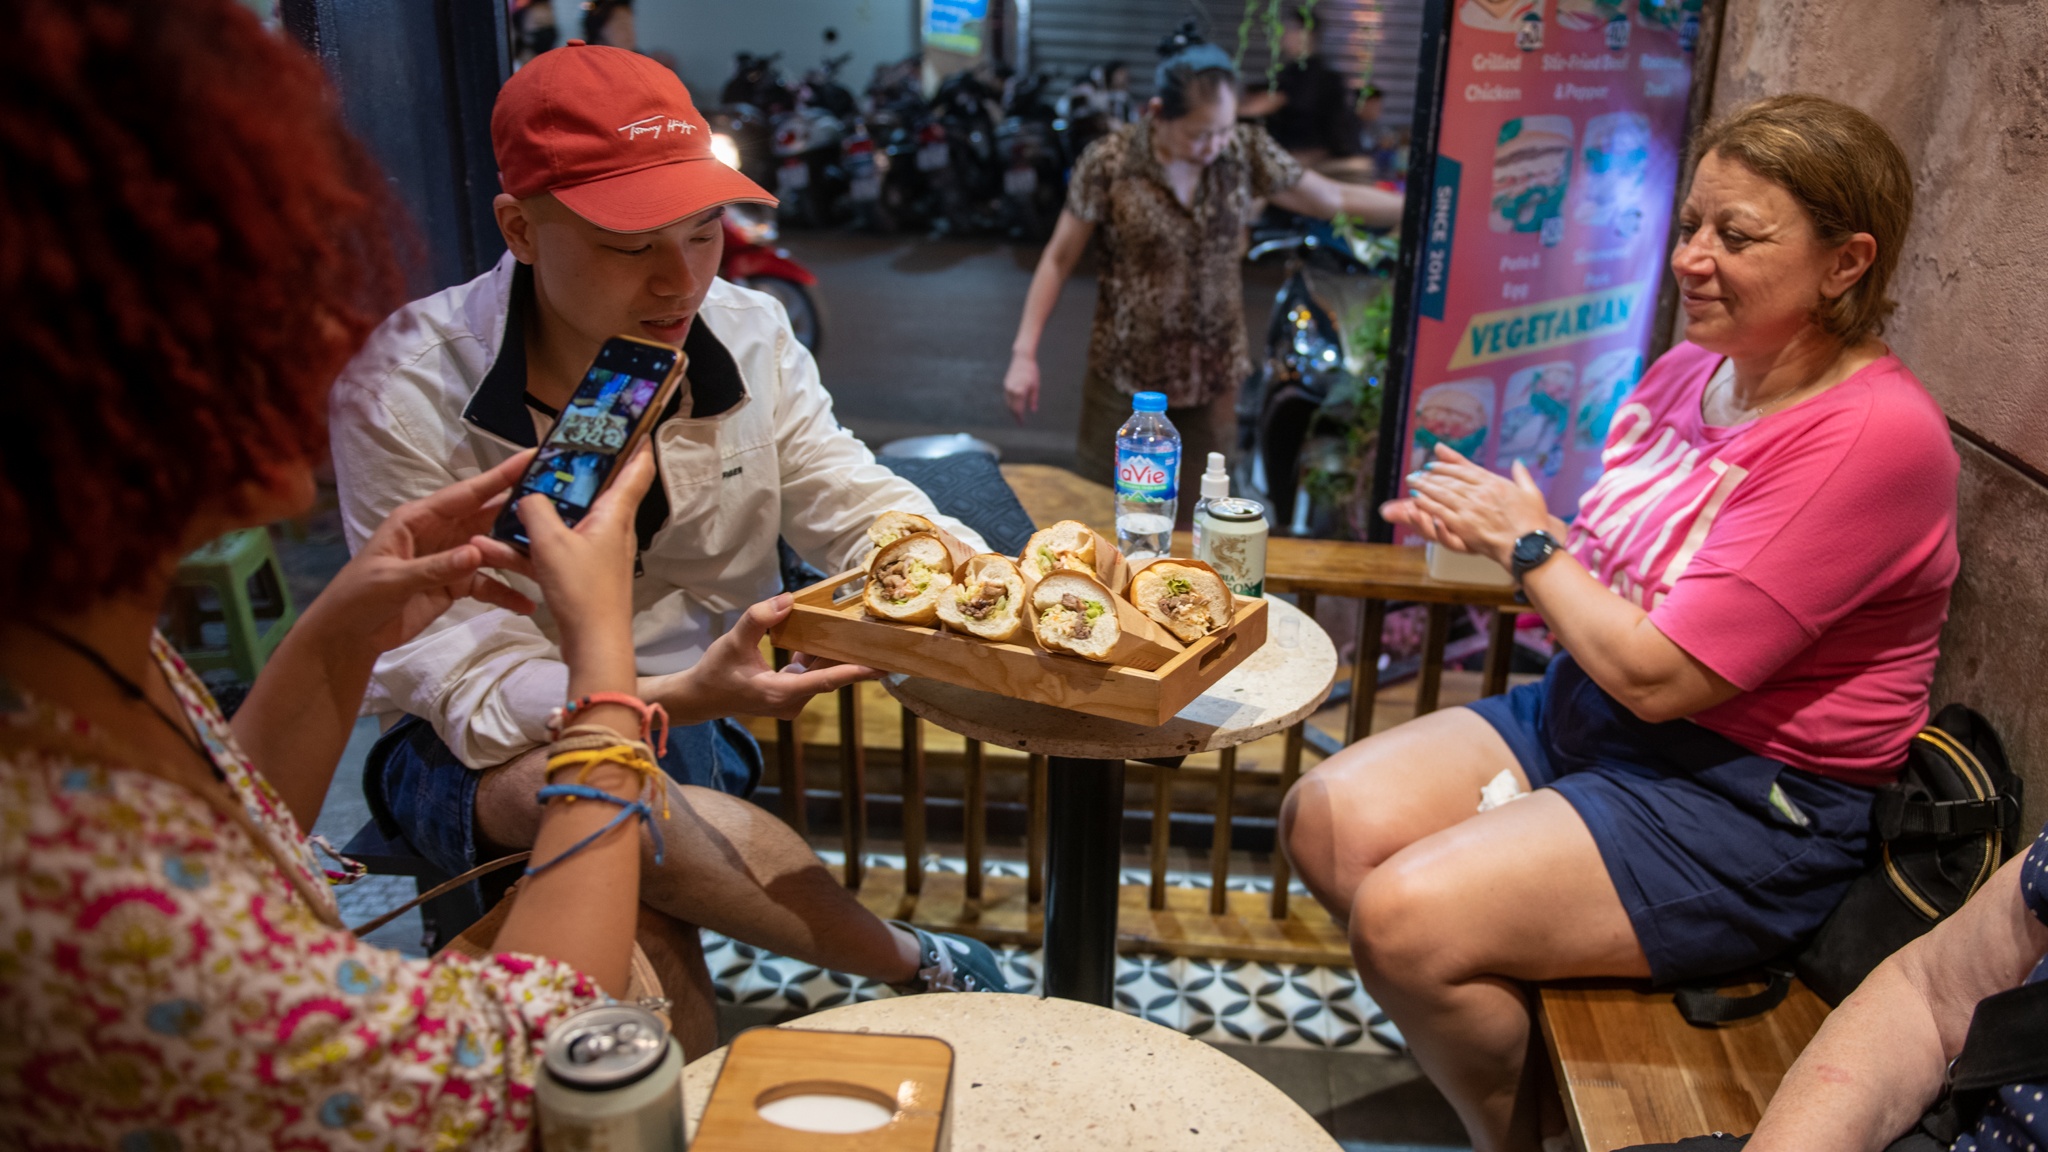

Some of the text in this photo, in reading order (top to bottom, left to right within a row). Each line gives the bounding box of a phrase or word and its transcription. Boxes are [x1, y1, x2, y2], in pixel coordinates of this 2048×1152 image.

[1472, 53, 1521, 72] Grilled
[1465, 83, 1521, 102] Chicken
[1566, 83, 1609, 102] Pepper
[1426, 184, 1453, 294] SINCE 2014
[1470, 295, 1633, 357] VEGETARIAN
